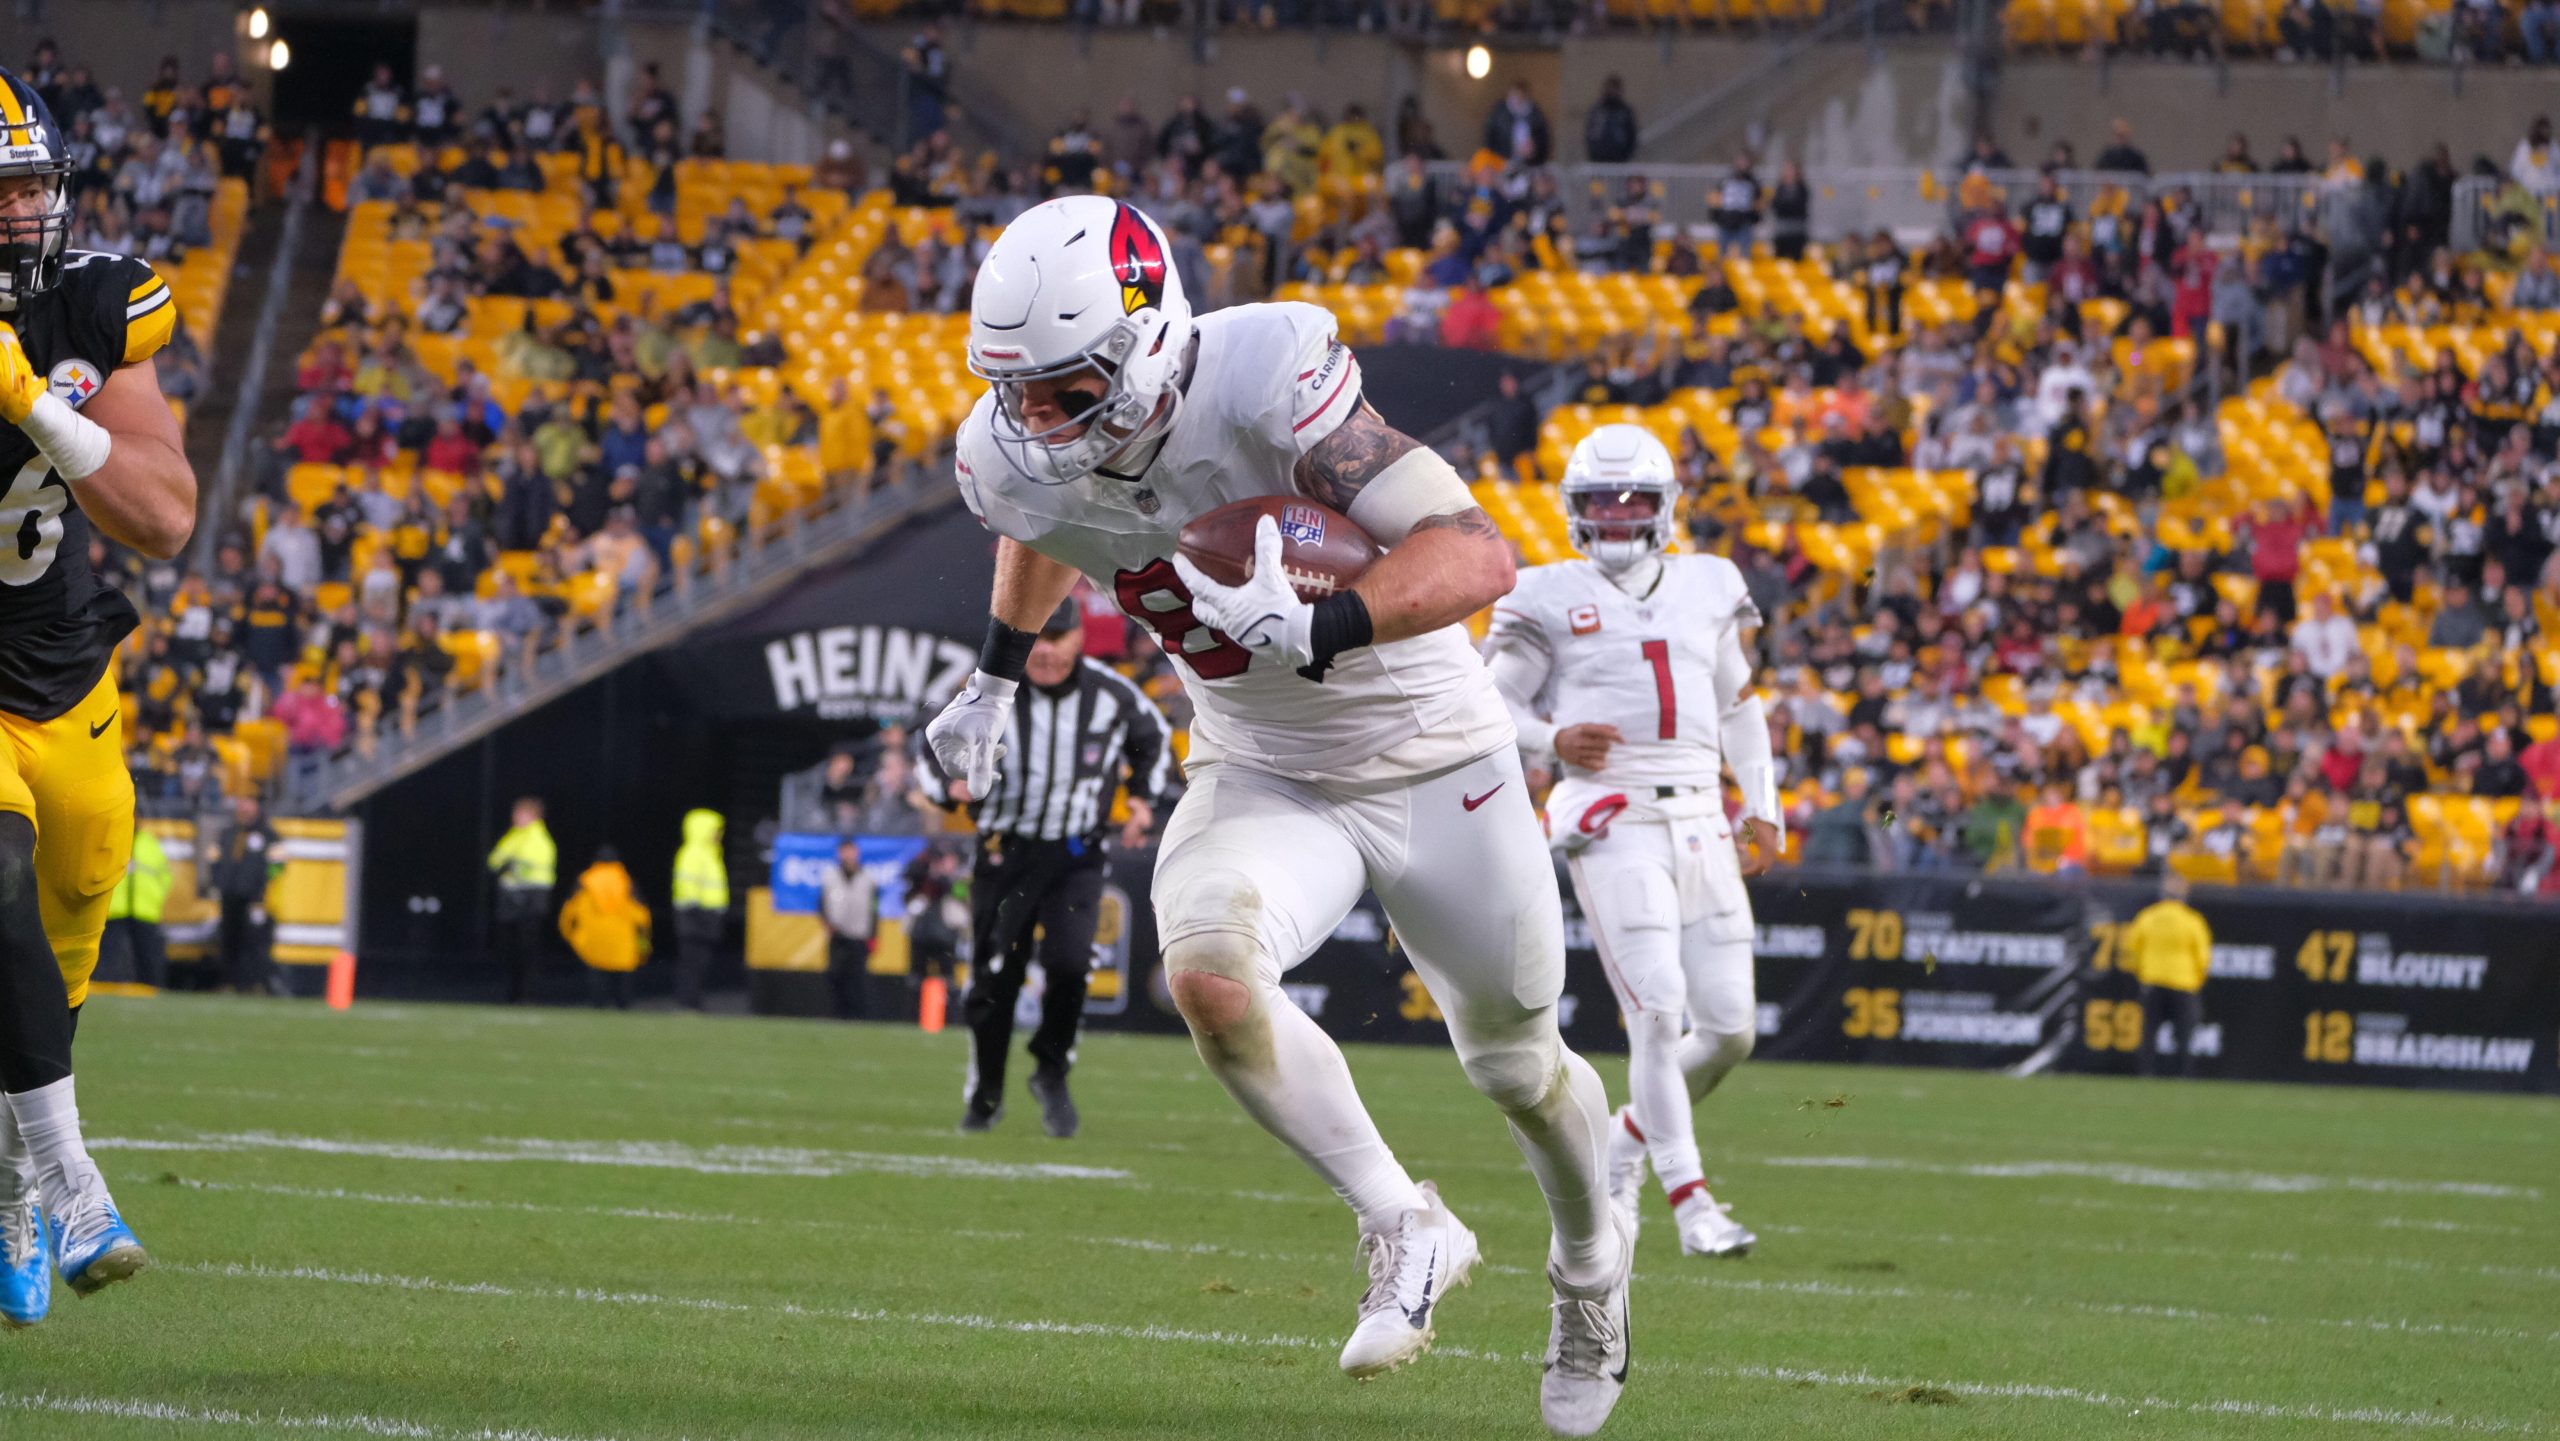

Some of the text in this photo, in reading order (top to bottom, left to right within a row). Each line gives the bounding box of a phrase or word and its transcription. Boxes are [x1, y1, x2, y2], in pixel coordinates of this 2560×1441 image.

[10, 148, 39, 159] Steelers
[53, 380, 74, 388] Steelers
[1288, 508, 1320, 528] NFL
[1571, 608, 1598, 628] C
[765, 624, 977, 711] HEINZ
[1641, 639, 1676, 740] 1
[1846, 908, 1902, 961] 70
[2295, 930, 2355, 982] 47
[2357, 953, 2488, 989] BLOUNT
[1843, 987, 1900, 1039] 35
[1900, 1010, 2043, 1046] JOHNSON
[2084, 999, 2144, 1051] 59
[2304, 1010, 2353, 1063] 12
[2353, 1032, 2535, 1074] BRADSHAW
